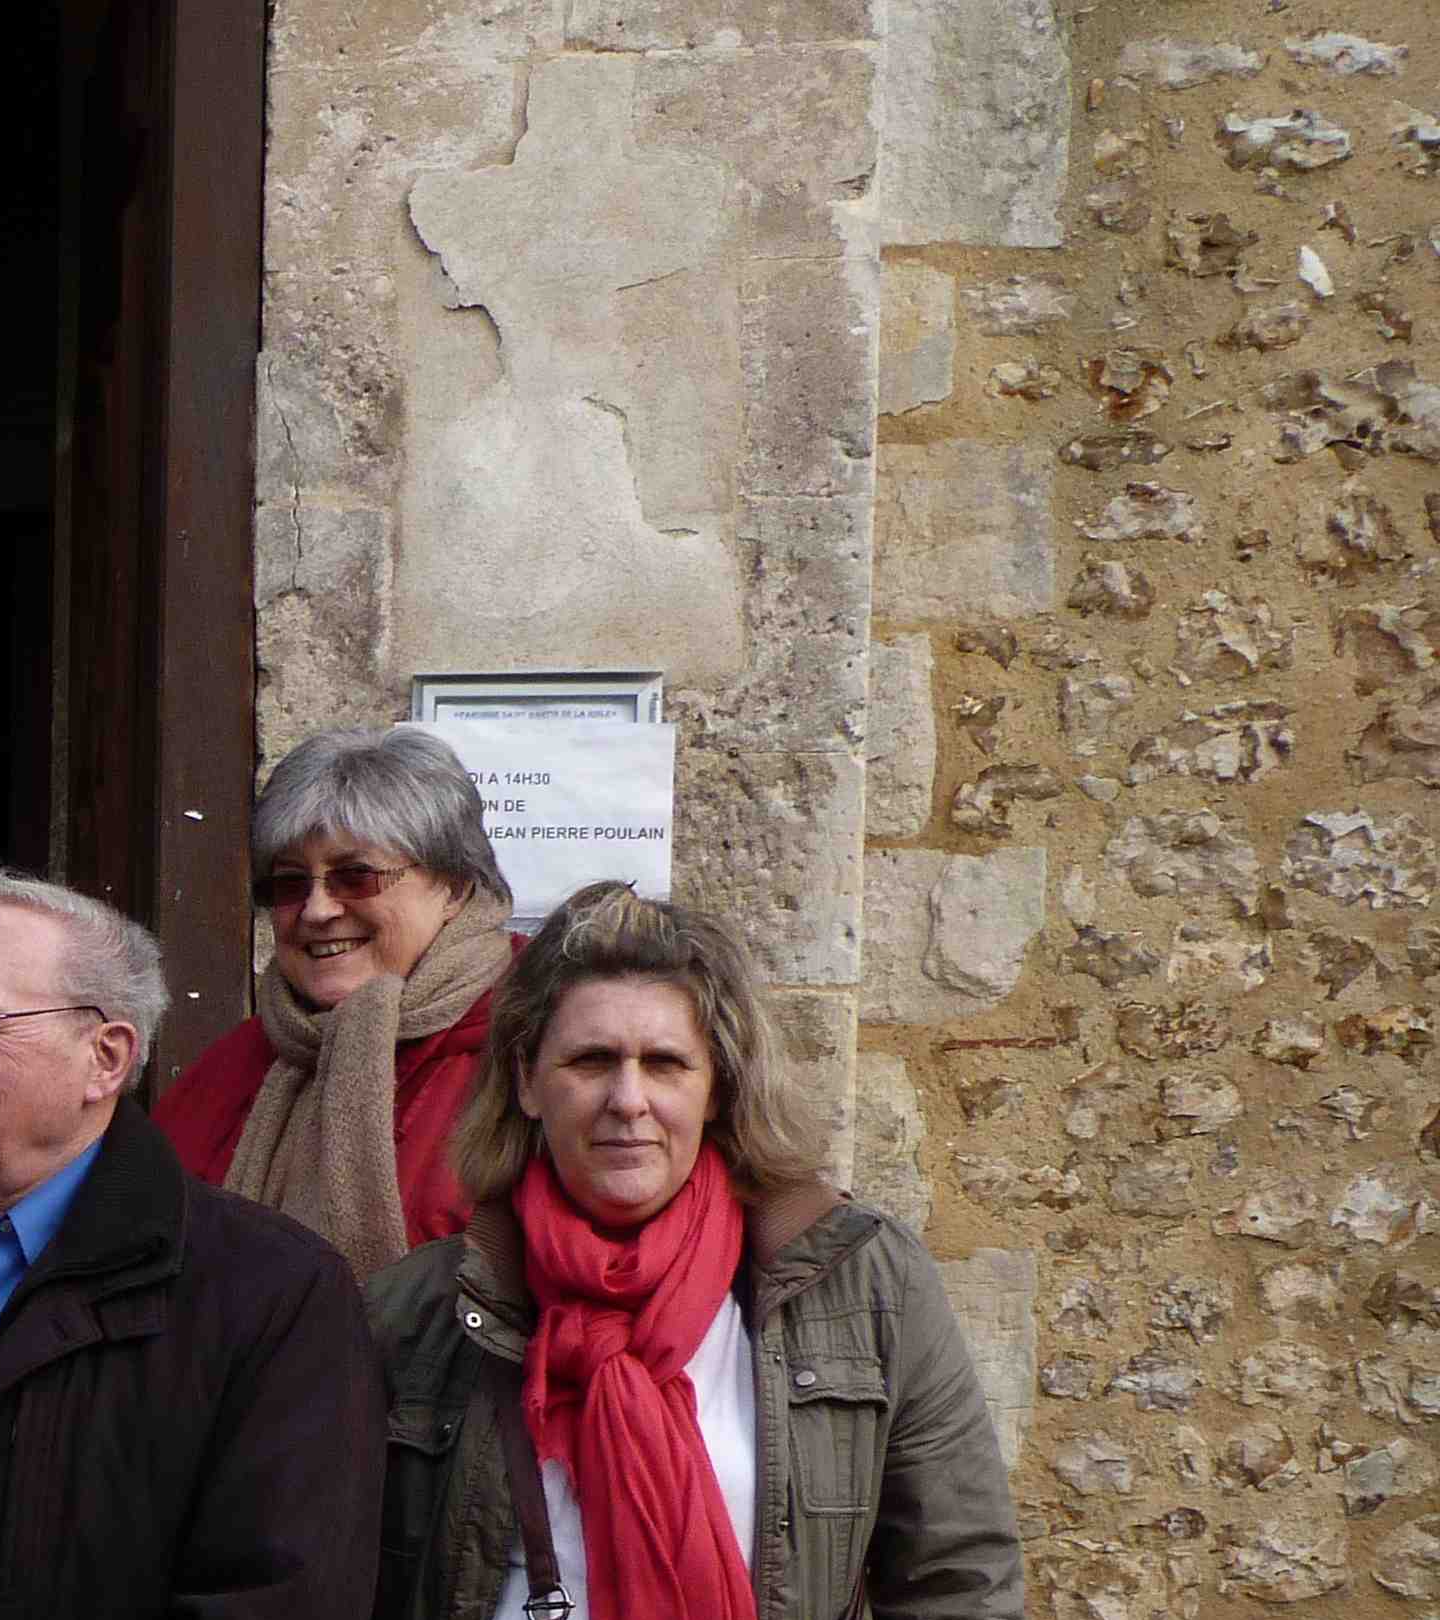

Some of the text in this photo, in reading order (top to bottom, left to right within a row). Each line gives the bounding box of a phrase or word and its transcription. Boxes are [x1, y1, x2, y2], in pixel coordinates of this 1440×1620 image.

[488, 772, 499, 785] A
[504, 772, 551, 785] 14H30
[503, 799, 526, 812] DE
[486, 826, 665, 840] JEAN PIERRE POULAIN
